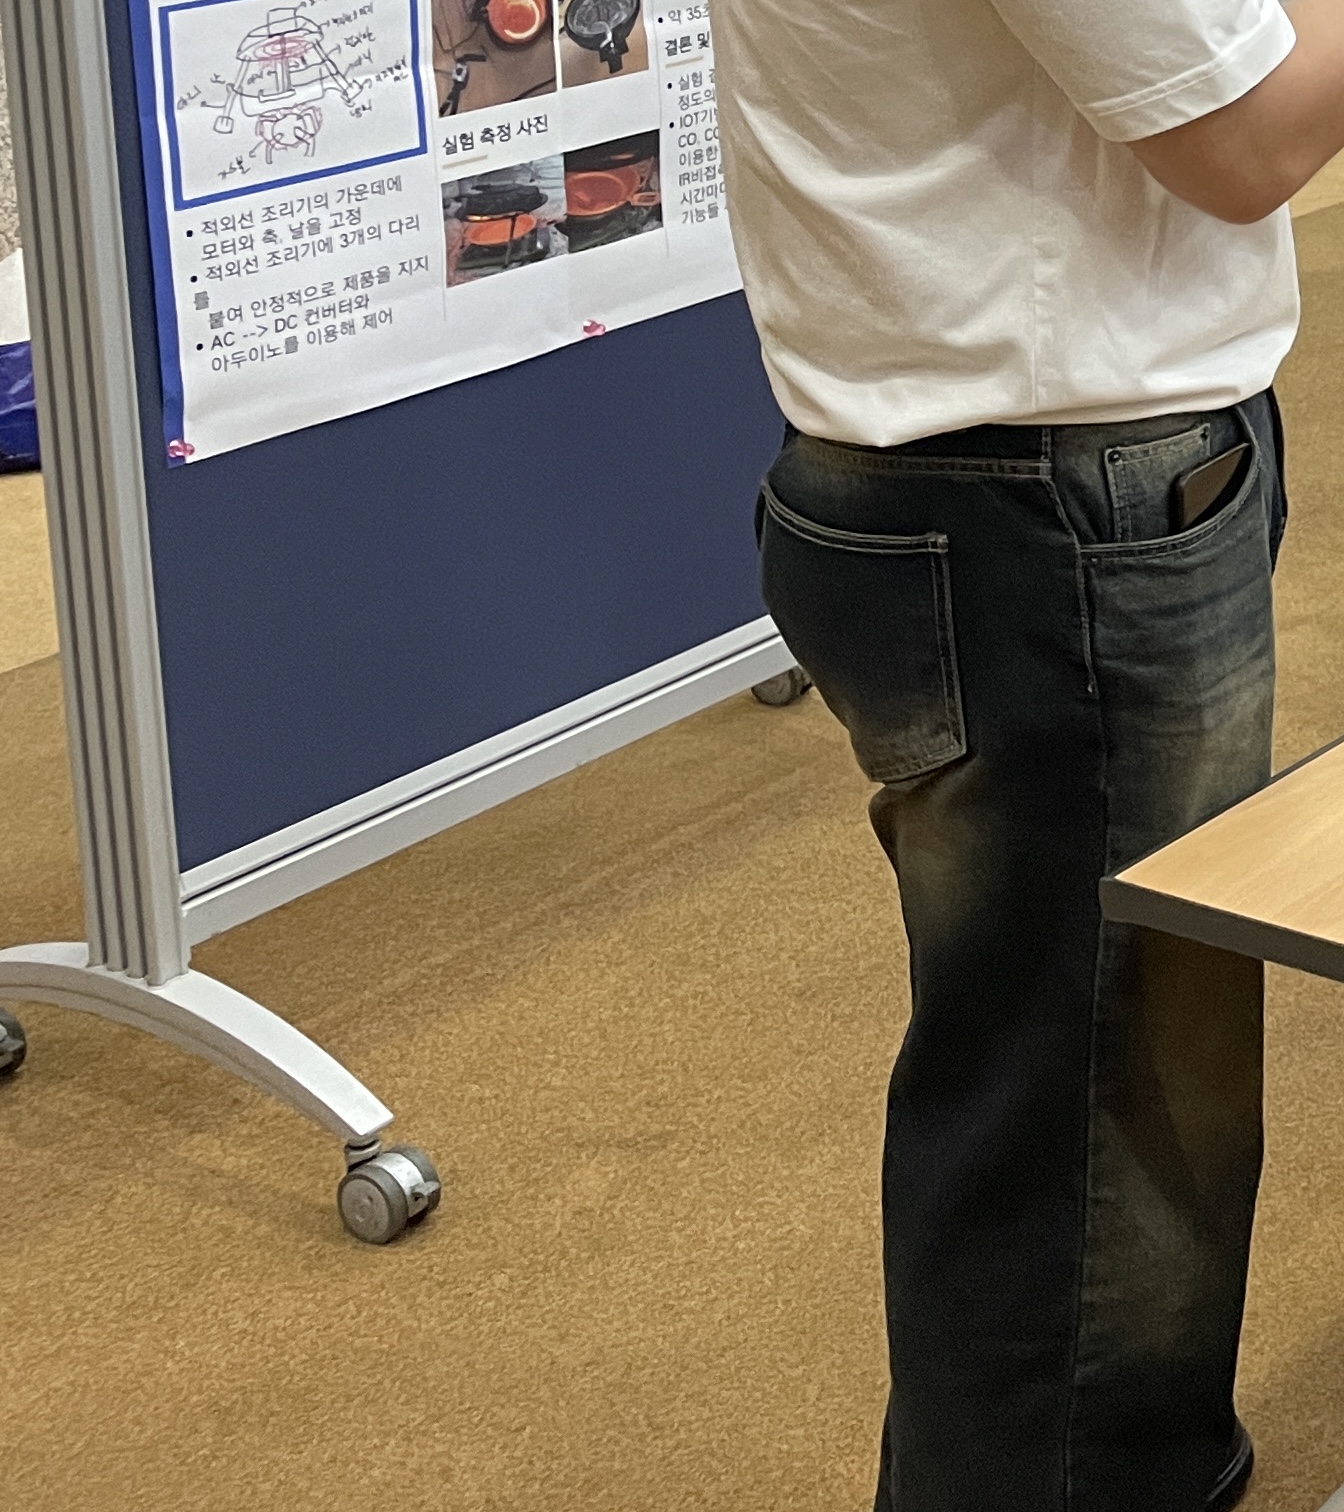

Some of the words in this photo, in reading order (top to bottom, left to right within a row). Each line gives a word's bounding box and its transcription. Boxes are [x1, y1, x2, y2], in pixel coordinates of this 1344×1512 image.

[668, 8, 682, 24] 약
[665, 36, 692, 57] 결론
[697, 31, 710, 49] 및
[678, 71, 703, 91] 실험
[442, 132, 474, 156] 실험
[480, 124, 512, 146] 측정
[517, 114, 548, 136] 사진
[679, 145, 719, 167] 이용한
[679, 165, 723, 187] IR비접
[201, 210, 254, 236] 적외선
[261, 193, 329, 222] 조리기의
[336, 175, 402, 204] 가운데에
[201, 235, 255, 262] 모터와
[288, 217, 322, 240] 날을
[328, 207, 362, 230] 고정
[206, 257, 259, 283] 적외선
[266, 239, 333, 268] 조리기에
[340, 224, 382, 249] 3개의
[388, 215, 419, 237] 다리
[194, 290, 209, 311] 를
[250, 282, 336, 318] 안정적으로
[343, 265, 390, 292] 제품을
[398, 255, 429, 277] 지지
[210, 331, 235, 351] AC
[274, 314, 298, 333] DC
[304, 293, 369, 324] 컨버터와
[211, 335, 299, 373] 아두이노를
[306, 324, 356, 346] 이용해
[362, 308, 393, 331] 제어
